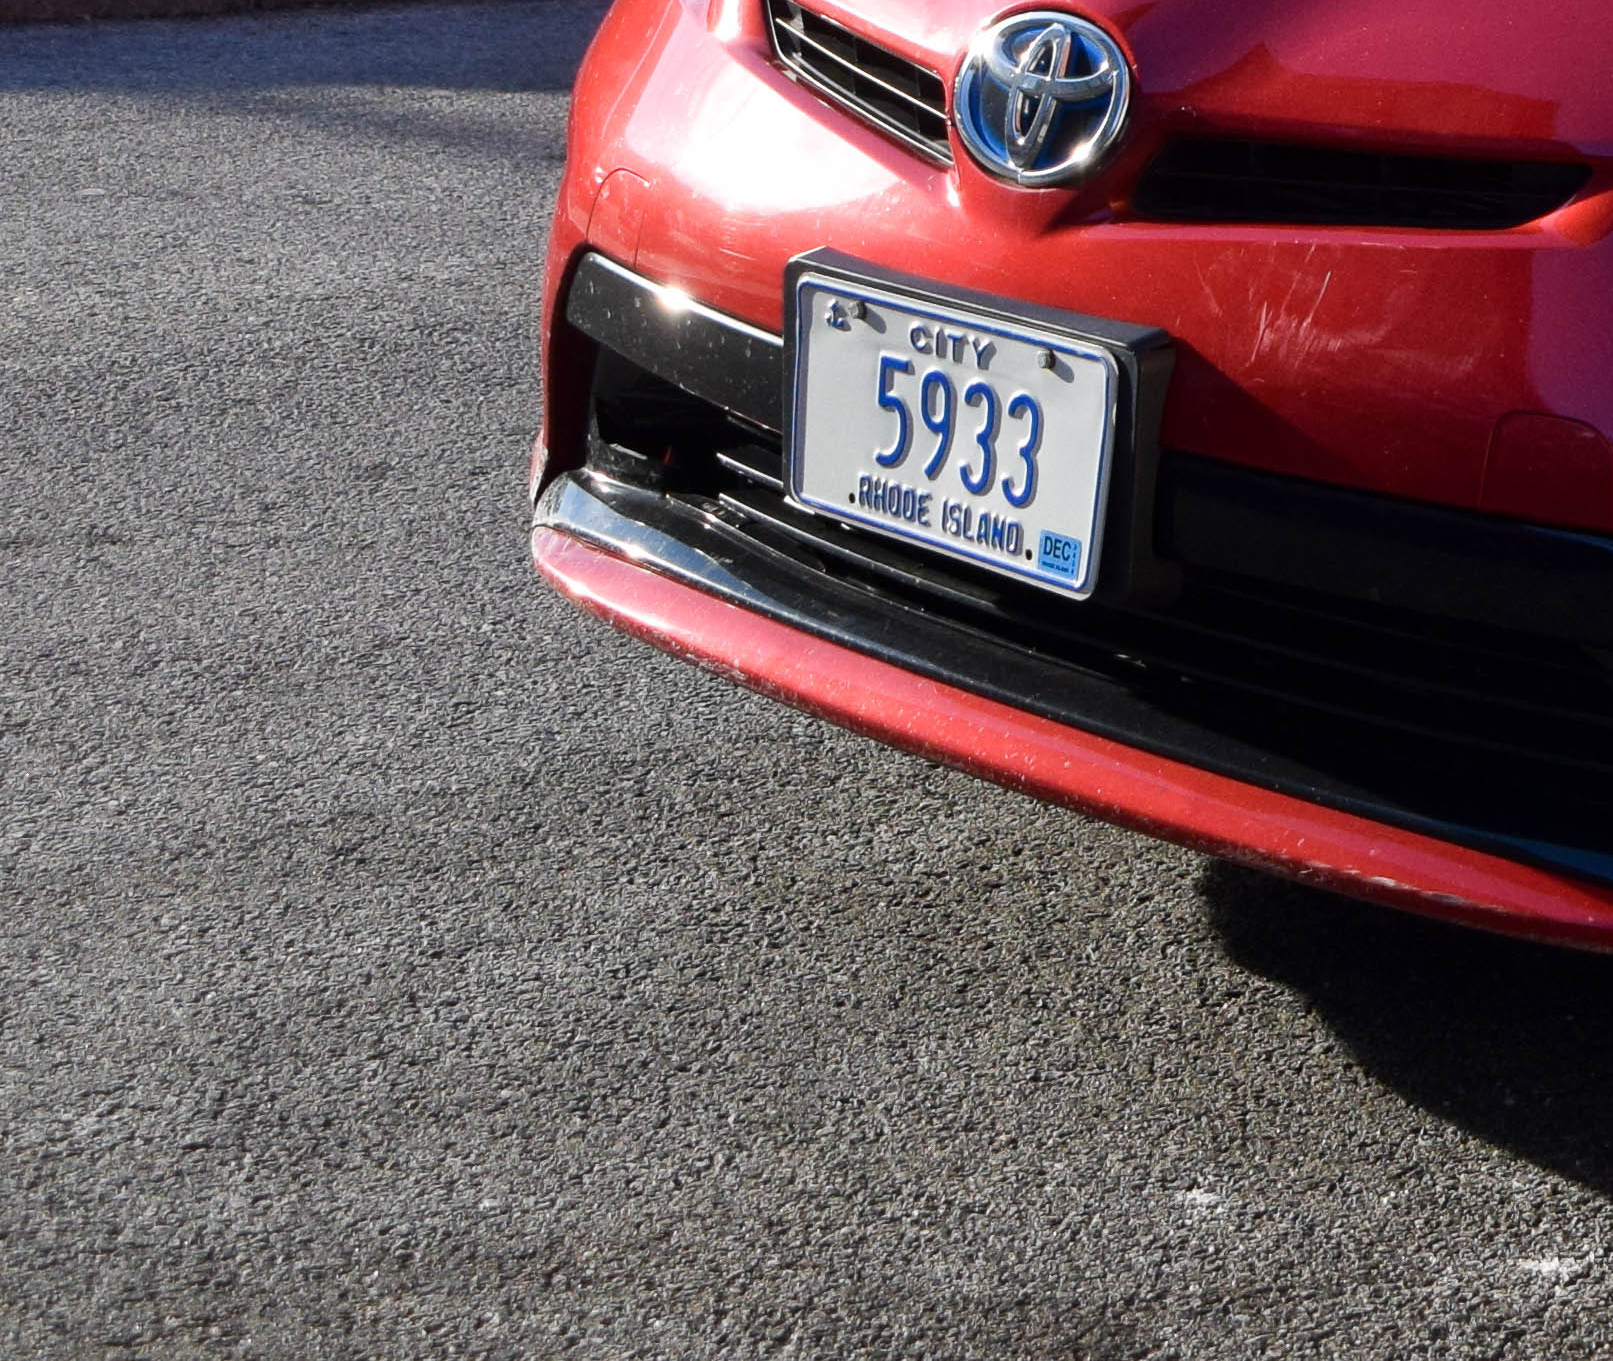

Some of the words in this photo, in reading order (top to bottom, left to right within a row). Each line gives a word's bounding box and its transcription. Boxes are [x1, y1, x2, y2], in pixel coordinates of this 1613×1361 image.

[910, 324, 994, 370] CITY
[876, 355, 1042, 506] 5933
[858, 476, 931, 525] RHODE
[942, 498, 1023, 553] ISLAND
[1044, 536, 1071, 560] DEC
